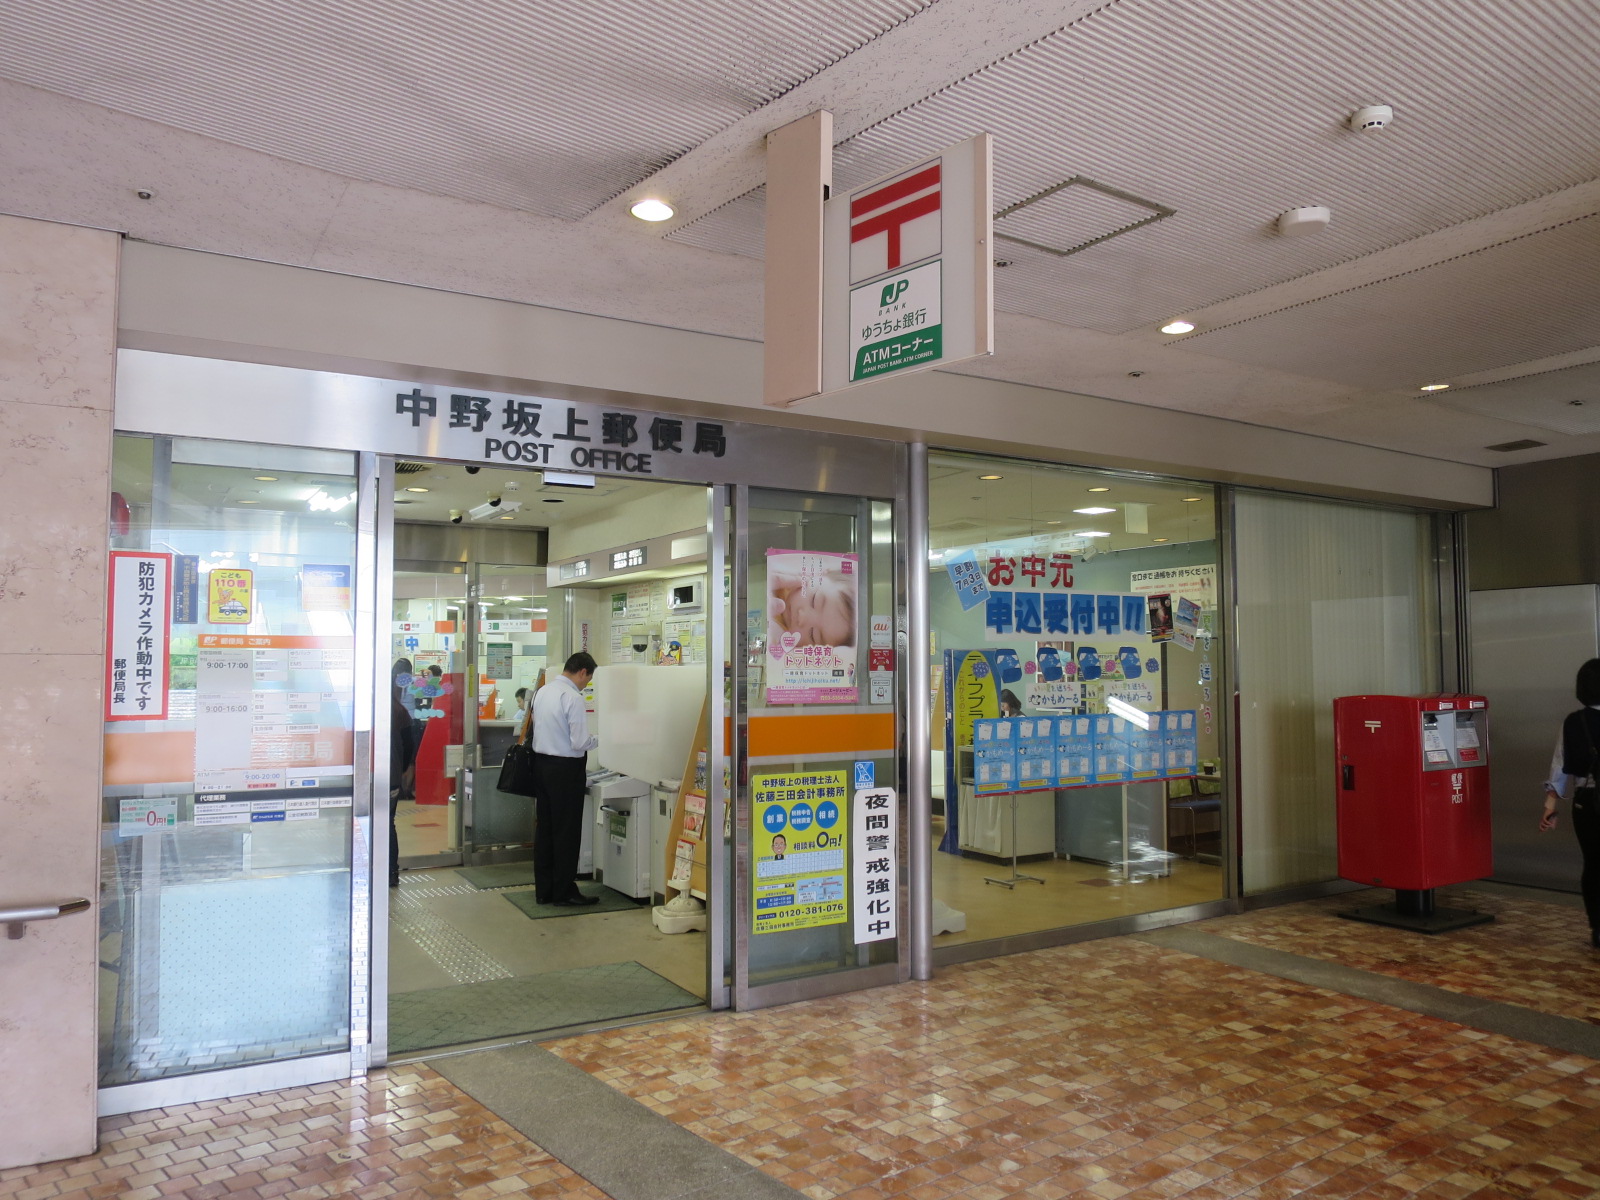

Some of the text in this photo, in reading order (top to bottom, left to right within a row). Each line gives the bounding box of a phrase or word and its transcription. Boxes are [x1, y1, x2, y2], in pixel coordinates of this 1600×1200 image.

[879, 302, 907, 316] BANK
[862, 308, 927, 340] ゆうちょ銀行
[863, 338, 934, 366] ATMコーナー
[863, 366, 877, 374] JAPAN
[890, 358, 902, 367] BANK
[903, 355, 914, 363] ATM
[915, 351, 934, 361] CORNER
[396, 388, 727, 458] 中野坂上郵便局
[485, 438, 652, 473] POST OFFICE
[954, 560, 974, 577] 早割
[987, 552, 1074, 588] お中元
[1132, 567, 1214, 582] 窓口まで通帳をお持ちください
[215, 579, 247, 588] 110番
[955, 571, 983, 591] 7月3日
[971, 582, 985, 595] まで
[986, 596, 1142, 636] 申込受付中!!
[873, 623, 890, 632] au
[135, 561, 155, 711] 防犯カメラ作動中です
[794, 646, 832, 657] 一時保育
[206, 661, 249, 669] 9:00-17:00
[784, 656, 842, 667] ドットネット
[113, 658, 127, 704] 郵便局長
[205, 704, 248, 713] 9:00-16:00
[762, 775, 840, 788] 中野坂上の税理士法人
[756, 787, 845, 803] 佐藤三田会計事務所
[1451, 794, 1463, 804] POST
[766, 814, 784, 824] 創業
[819, 810, 835, 820] 相続
[865, 794, 890, 935] 夜間警戒強化中
[779, 904, 844, 918] 0120-381-076
